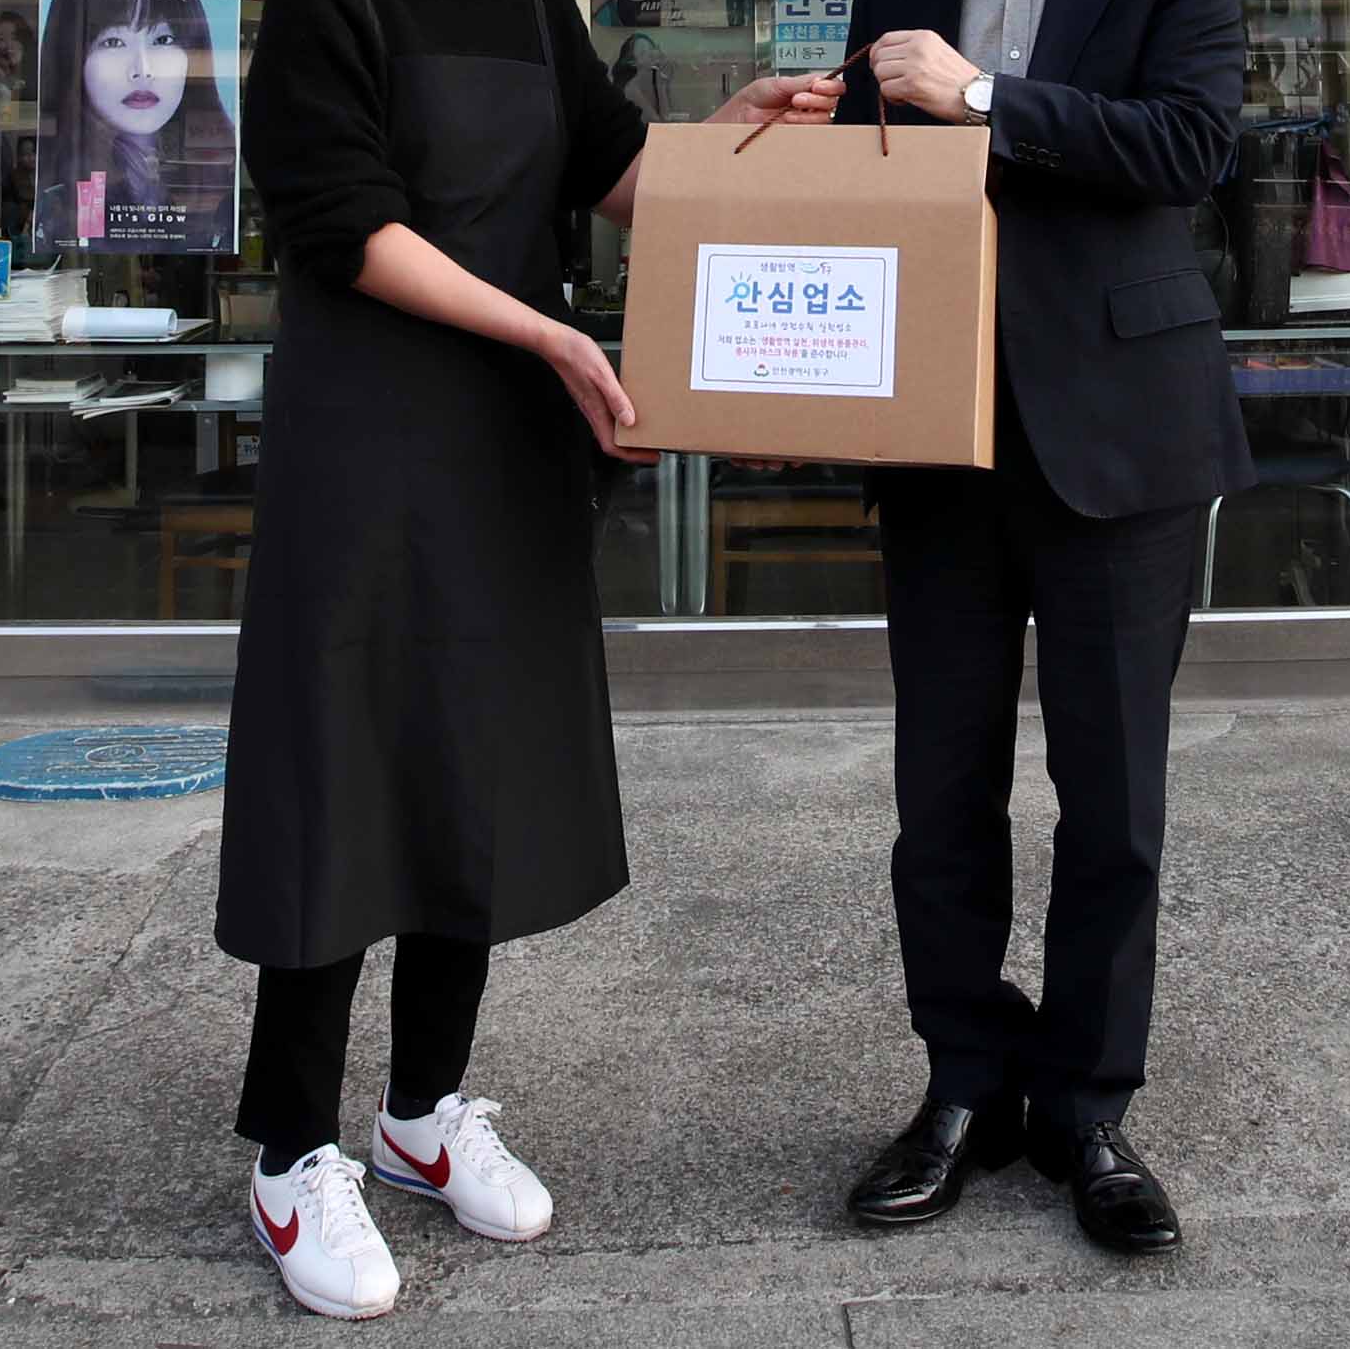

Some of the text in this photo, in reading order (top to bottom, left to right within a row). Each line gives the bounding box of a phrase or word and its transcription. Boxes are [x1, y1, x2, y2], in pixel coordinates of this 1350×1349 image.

[110, 213, 187, 223] It's Glow
[725, 280, 866, 315] 안심업소
